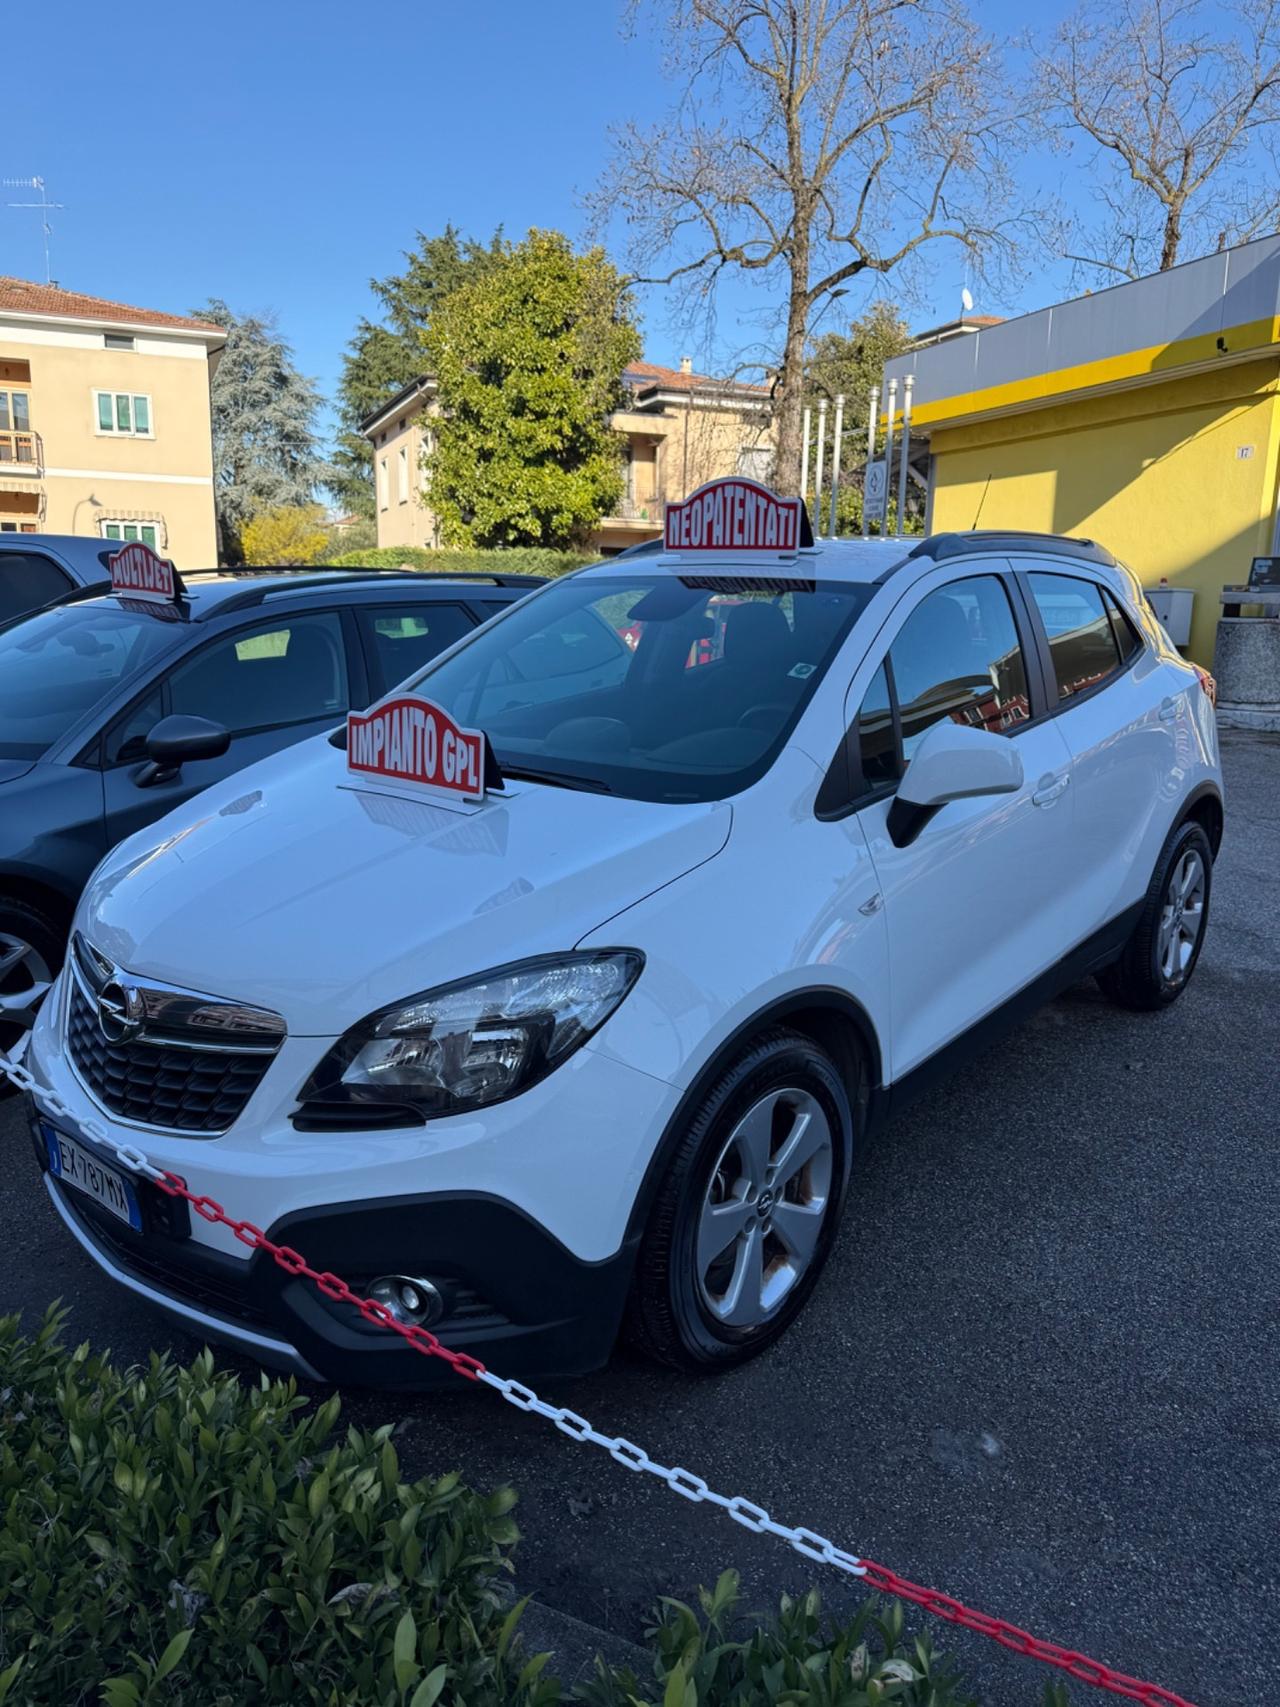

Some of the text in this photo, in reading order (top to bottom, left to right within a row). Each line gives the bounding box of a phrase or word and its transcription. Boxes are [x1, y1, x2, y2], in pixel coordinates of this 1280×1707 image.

[1240, 447, 1249, 459] 17
[669, 485, 794, 547] NEOPATENTATI
[112, 547, 169, 592] MULTIJET
[352, 706, 478, 787] IMPIANTO GPL
